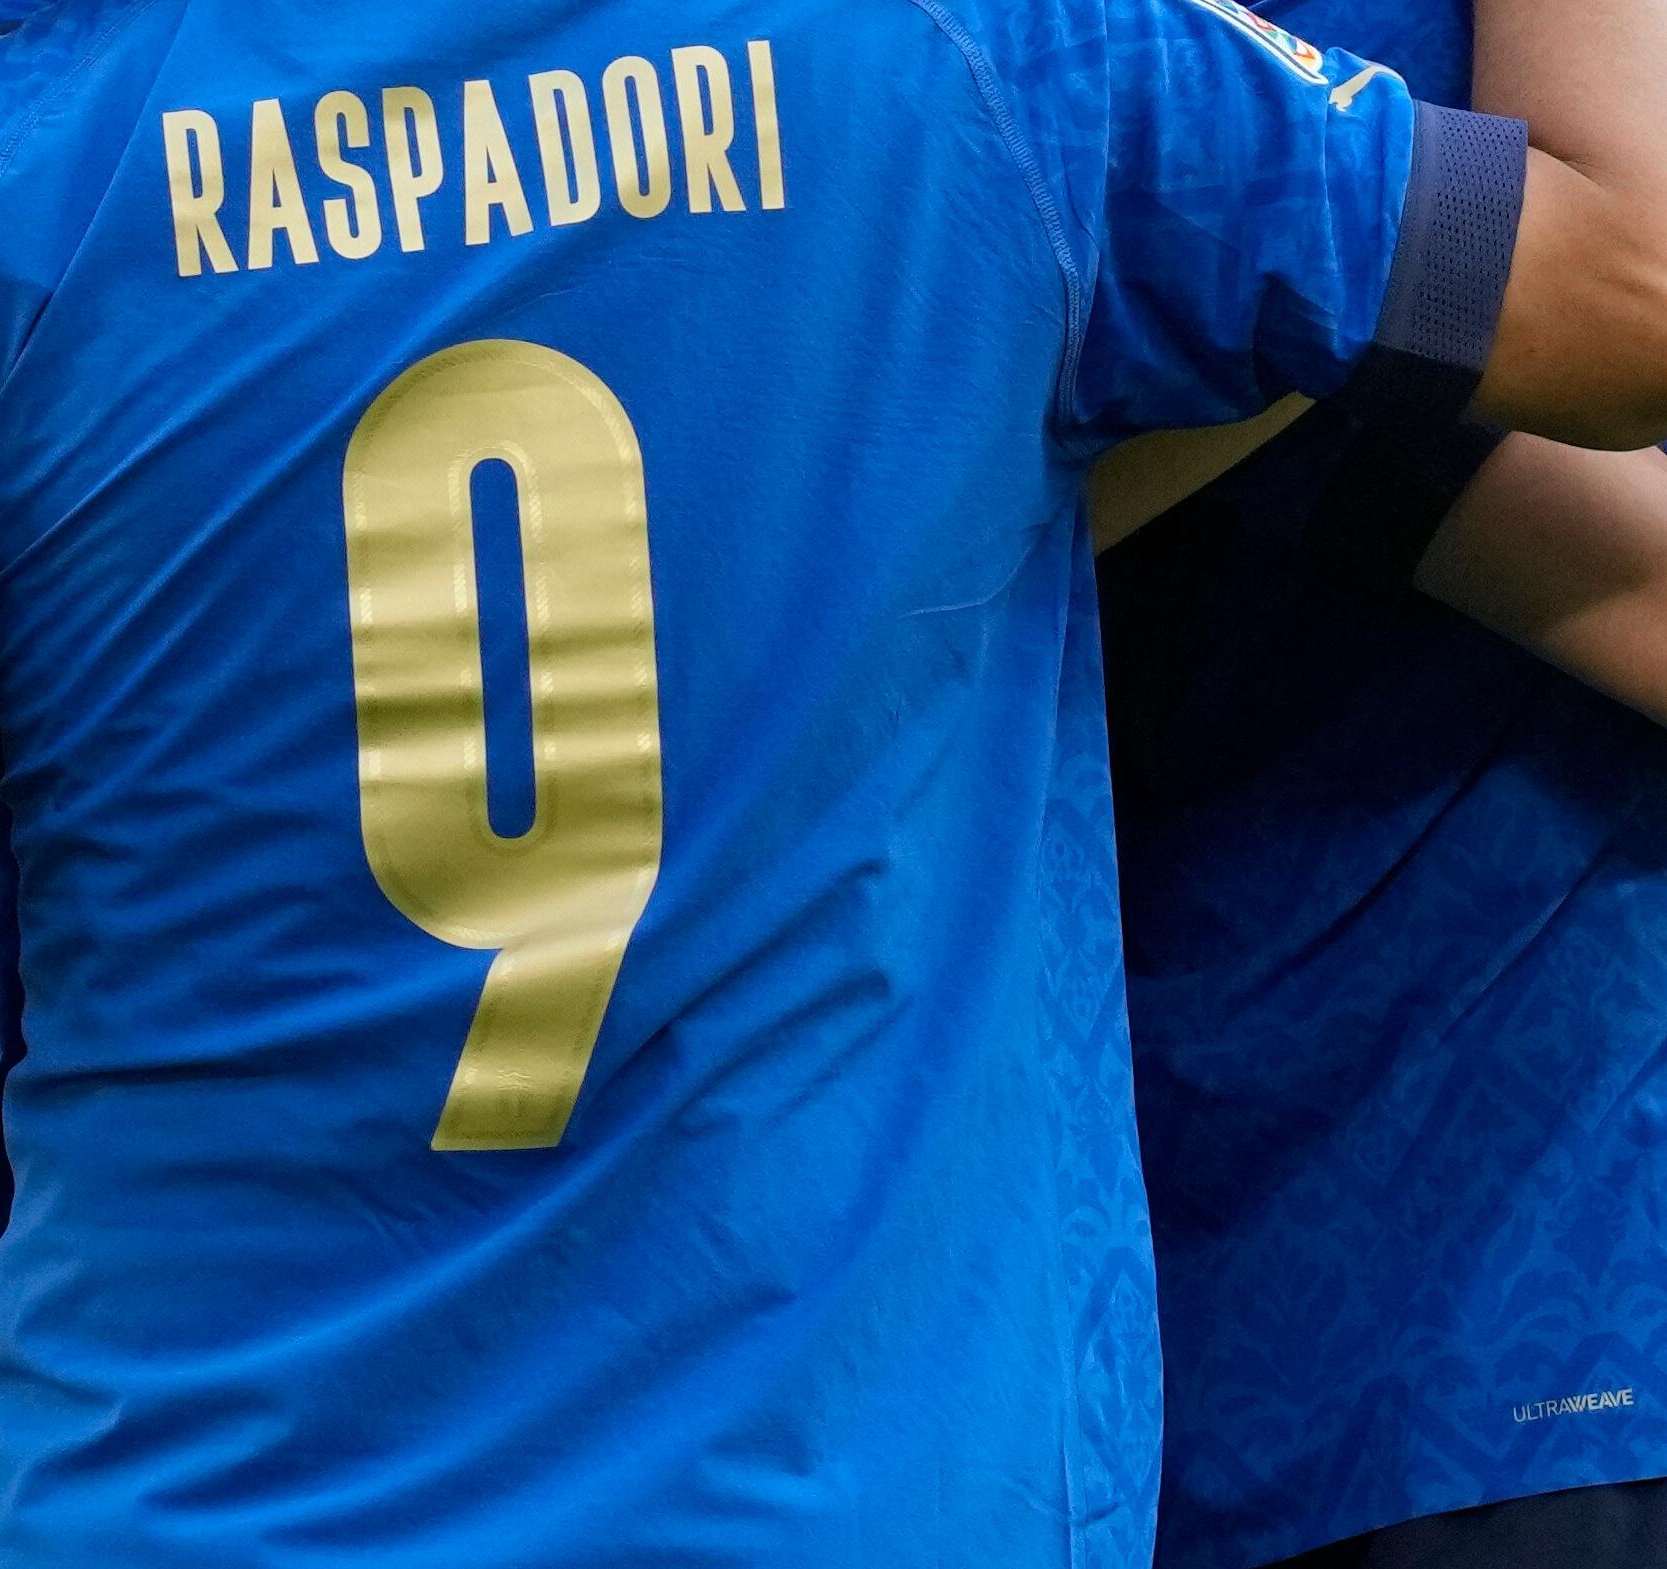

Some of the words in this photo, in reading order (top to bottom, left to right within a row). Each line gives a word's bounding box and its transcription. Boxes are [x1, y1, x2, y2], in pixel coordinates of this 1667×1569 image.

[161, 39, 785, 278] RASPADORI
[342, 338, 663, 1152] 9
[1512, 1387, 1635, 1423] ULTRAWEAVE
